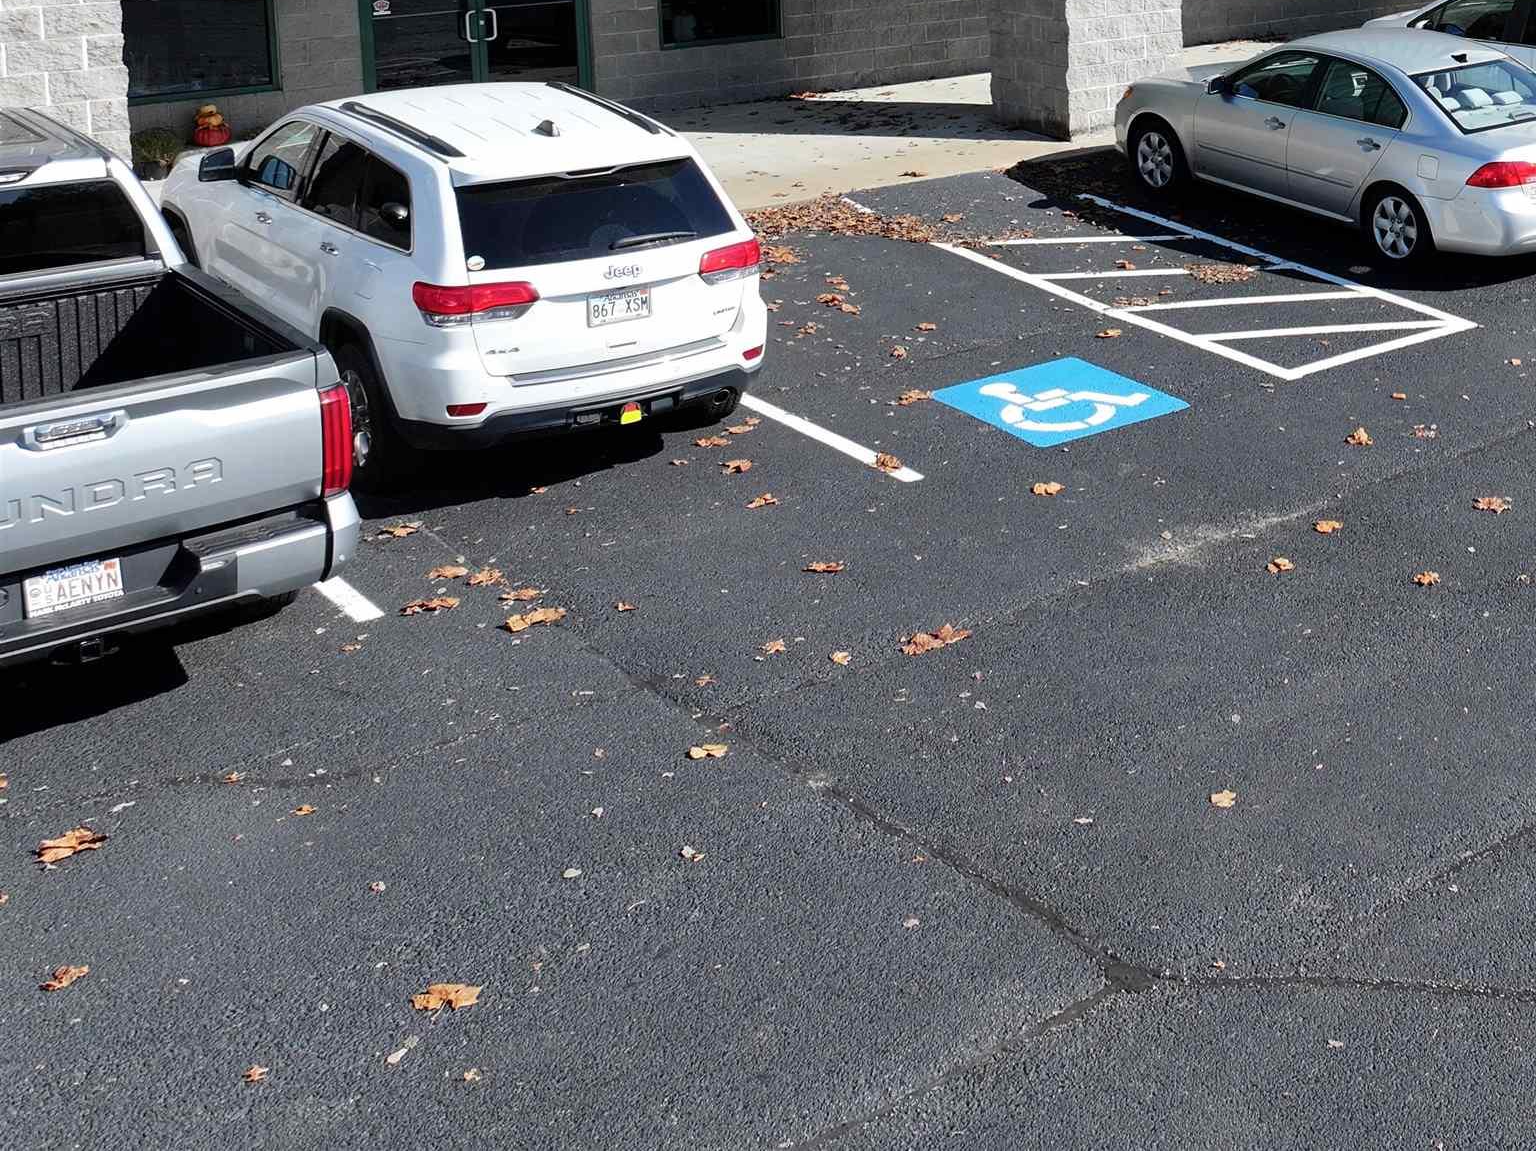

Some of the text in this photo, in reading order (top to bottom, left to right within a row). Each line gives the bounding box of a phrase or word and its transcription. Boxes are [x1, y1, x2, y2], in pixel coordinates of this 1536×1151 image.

[604, 264, 643, 279] Jeep
[592, 296, 649, 319] 867 XSM
